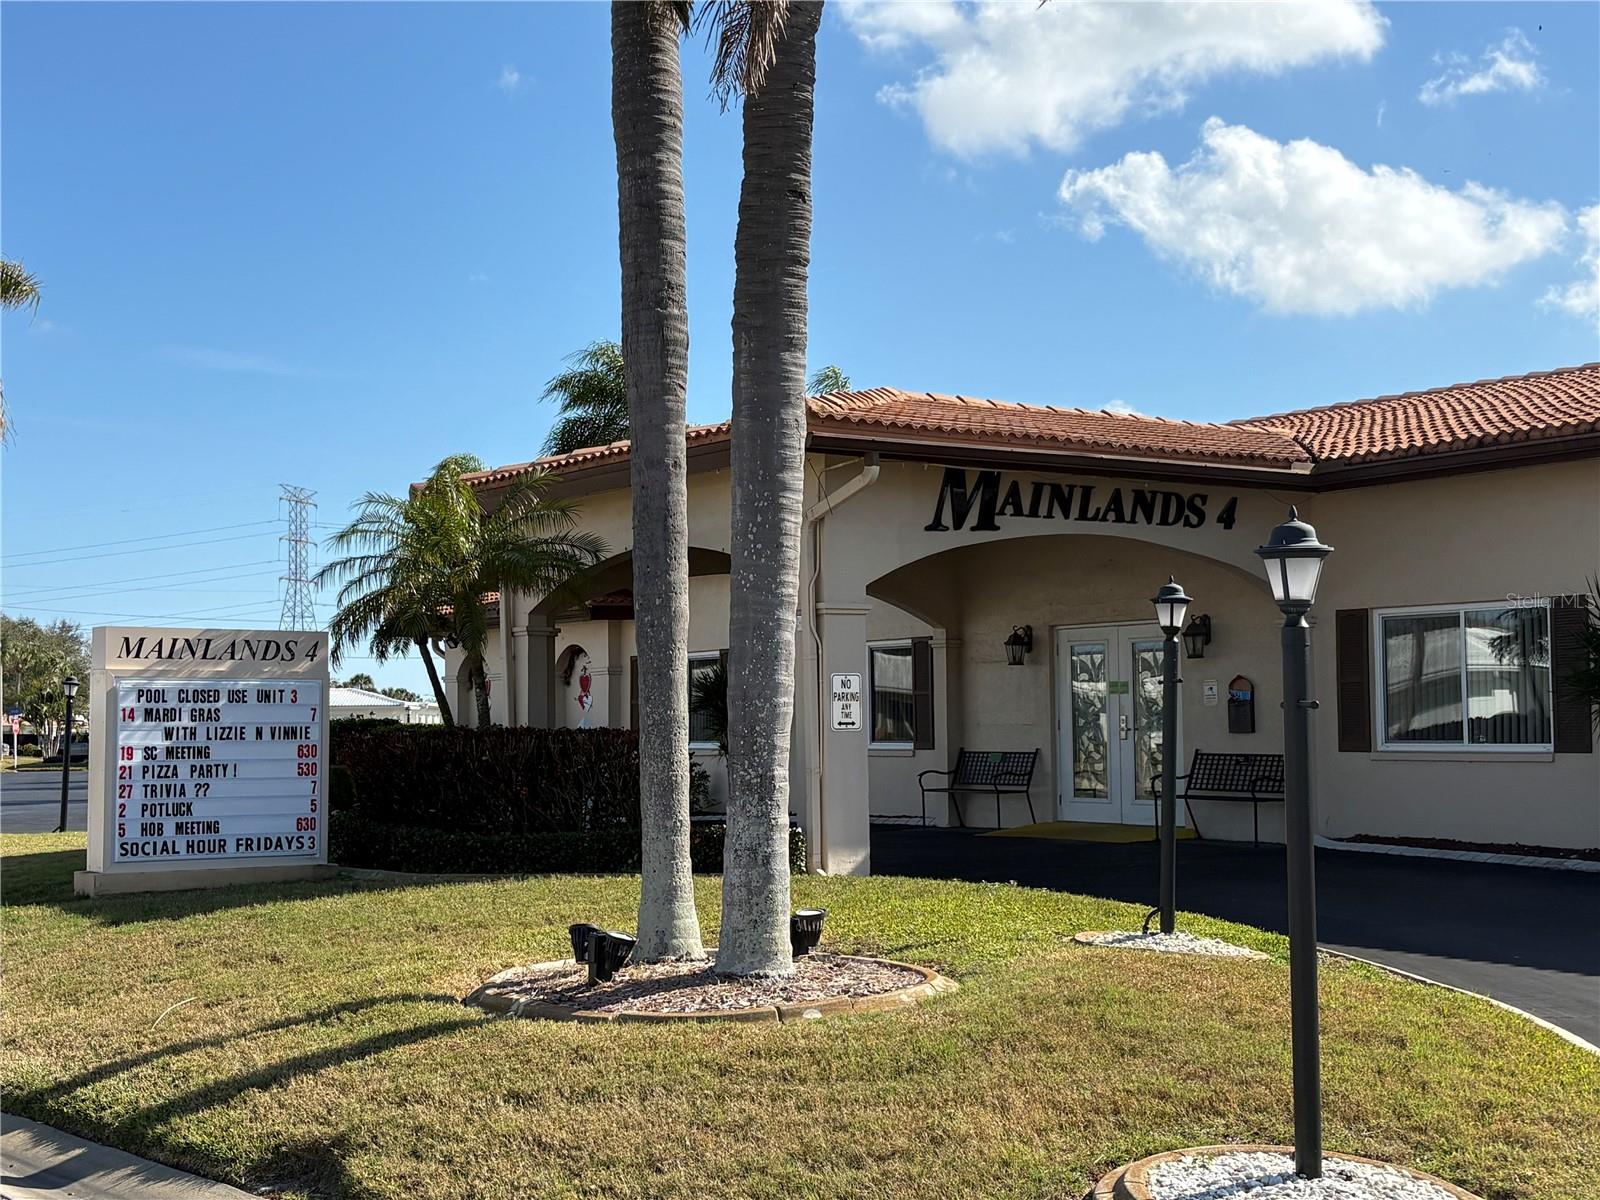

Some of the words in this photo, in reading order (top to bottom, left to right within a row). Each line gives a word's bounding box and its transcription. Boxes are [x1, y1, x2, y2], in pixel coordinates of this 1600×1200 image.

[924, 467, 1208, 532] MAINLANDS
[1216, 497, 1238, 530] 4
[116, 637, 299, 662] MAINLANDS
[305, 641, 320, 662] 4
[841, 679, 851, 689] NO
[138, 689, 168, 704] POOL
[178, 689, 220, 703] CLOSED
[228, 689, 248, 703] USE
[257, 689, 285, 703] UNIT
[290, 689, 298, 703] 3
[834, 692, 859, 702] PARKING
[121, 708, 135, 722] 14
[144, 708, 182, 722] MARDI
[190, 708, 221, 722] GRAS
[310, 708, 317, 721] 7
[841, 711, 852, 719] TIME
[164, 727, 197, 741] WITH
[206, 727, 246, 740] LIZZIE
[256, 727, 262, 740] N
[270, 726, 311, 740] VINNIE
[120, 746, 134, 761] 19
[143, 746, 157, 760] SC
[165, 746, 210, 760] MEETING
[297, 744, 317, 758] 630
[119, 766, 132, 780] 21
[142, 765, 179, 779] PIZZA
[297, 762, 317, 777] 530
[119, 784, 133, 799] 27
[143, 783, 186, 798] TRIVIA
[194, 783, 210, 797] ??
[311, 781, 317, 795] 7
[119, 803, 126, 818] 2
[141, 802, 193, 817] POTLUCK
[311, 799, 317, 813] 5
[118, 823, 125, 837] 5
[175, 820, 220, 836] MEETING
[296, 817, 316, 831] 630
[120, 840, 180, 856] SOCIAL
[186, 839, 226, 854] HOUR
[236, 836, 305, 852] FRIDAYS
[308, 836, 315, 850] 3
